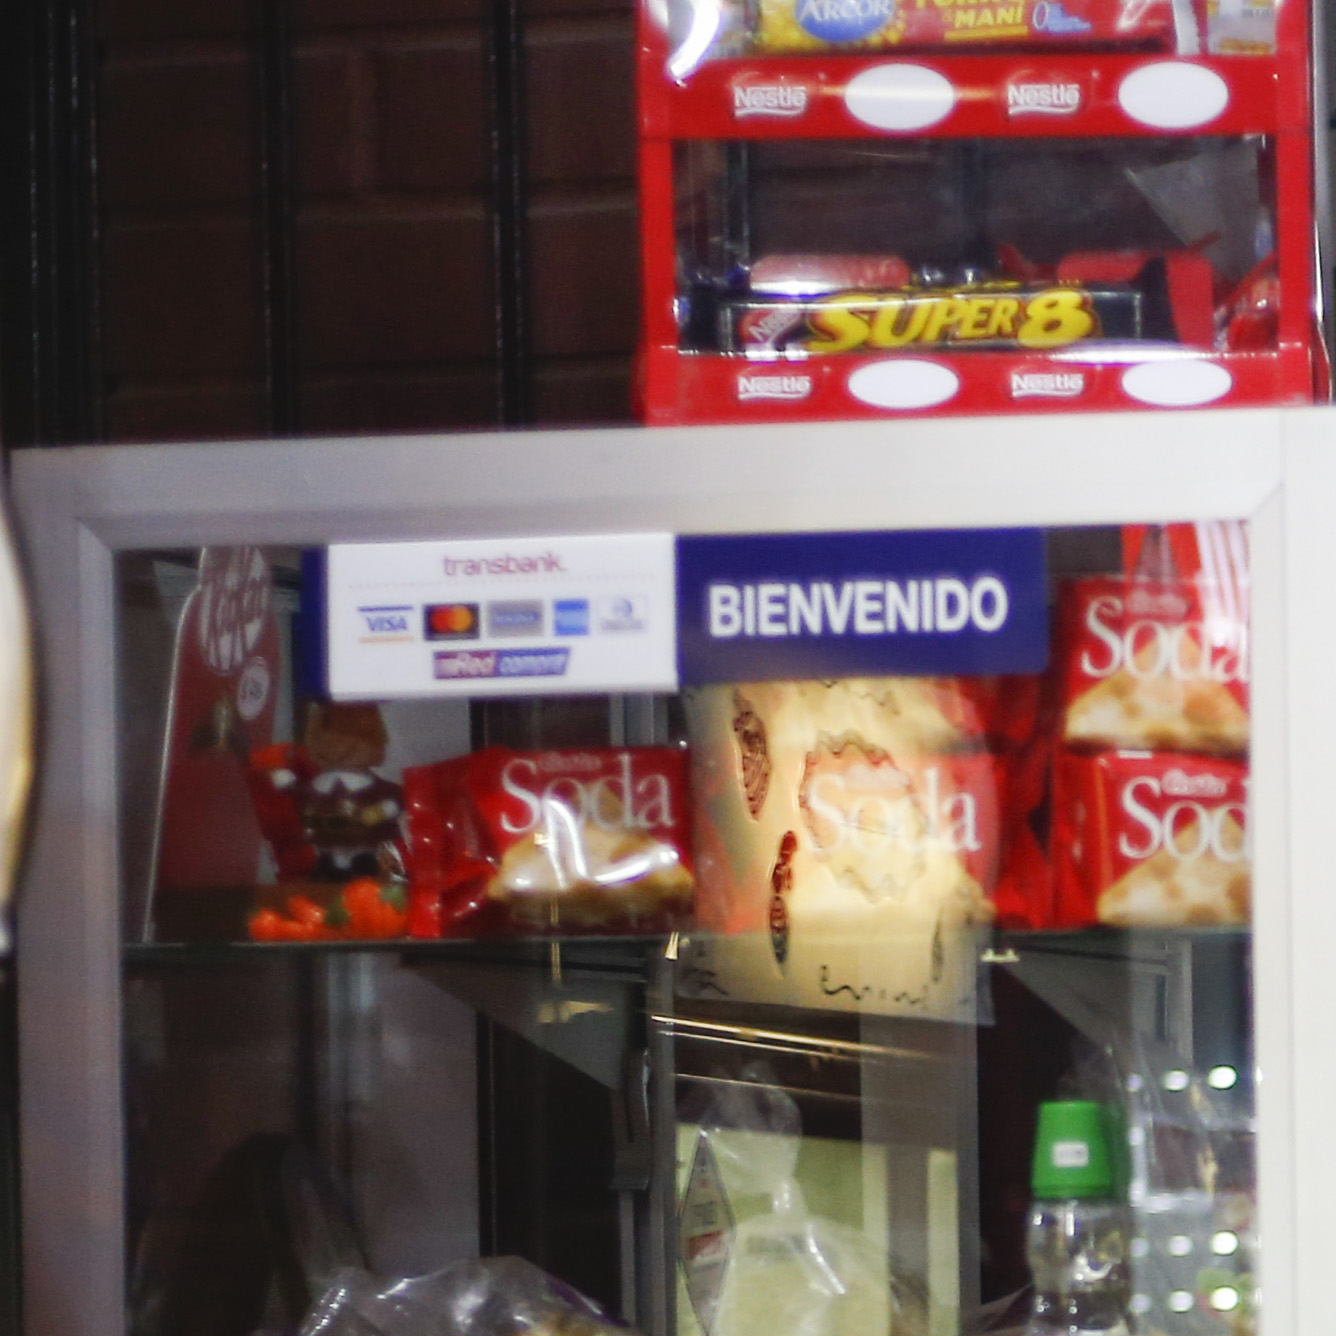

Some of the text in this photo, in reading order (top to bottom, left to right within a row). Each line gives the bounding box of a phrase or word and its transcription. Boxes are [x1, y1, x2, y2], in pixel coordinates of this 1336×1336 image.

[806, 293, 1015, 354] SUPER
[1017, 288, 1093, 349] 8
[366, 616, 408, 632] VISA
[709, 576, 1009, 638] BIENVENIDO
[501, 753, 674, 833] Soda
[806, 766, 982, 852] Soda
